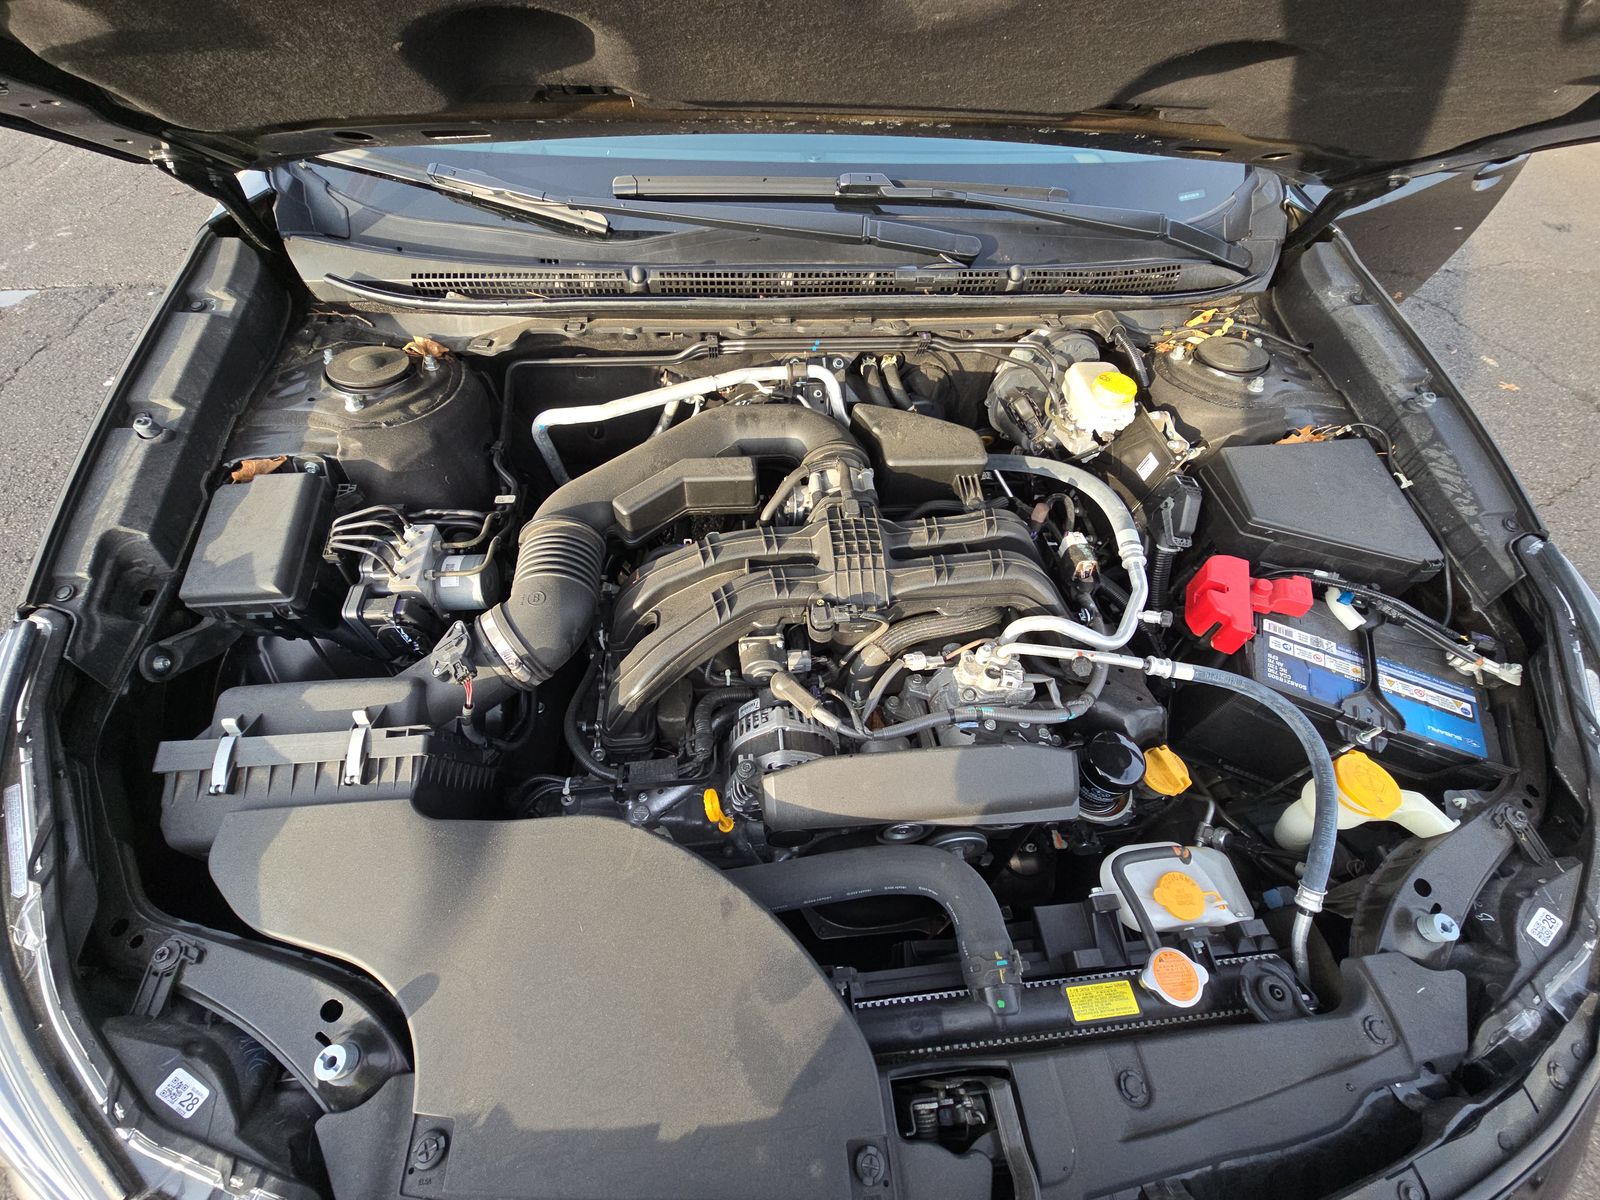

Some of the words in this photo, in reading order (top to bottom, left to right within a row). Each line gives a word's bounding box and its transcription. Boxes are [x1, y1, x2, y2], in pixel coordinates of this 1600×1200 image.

[1427, 725, 1463, 740] SUBARU
[1541, 914, 1557, 930] 28
[178, 1092, 200, 1112] 28
